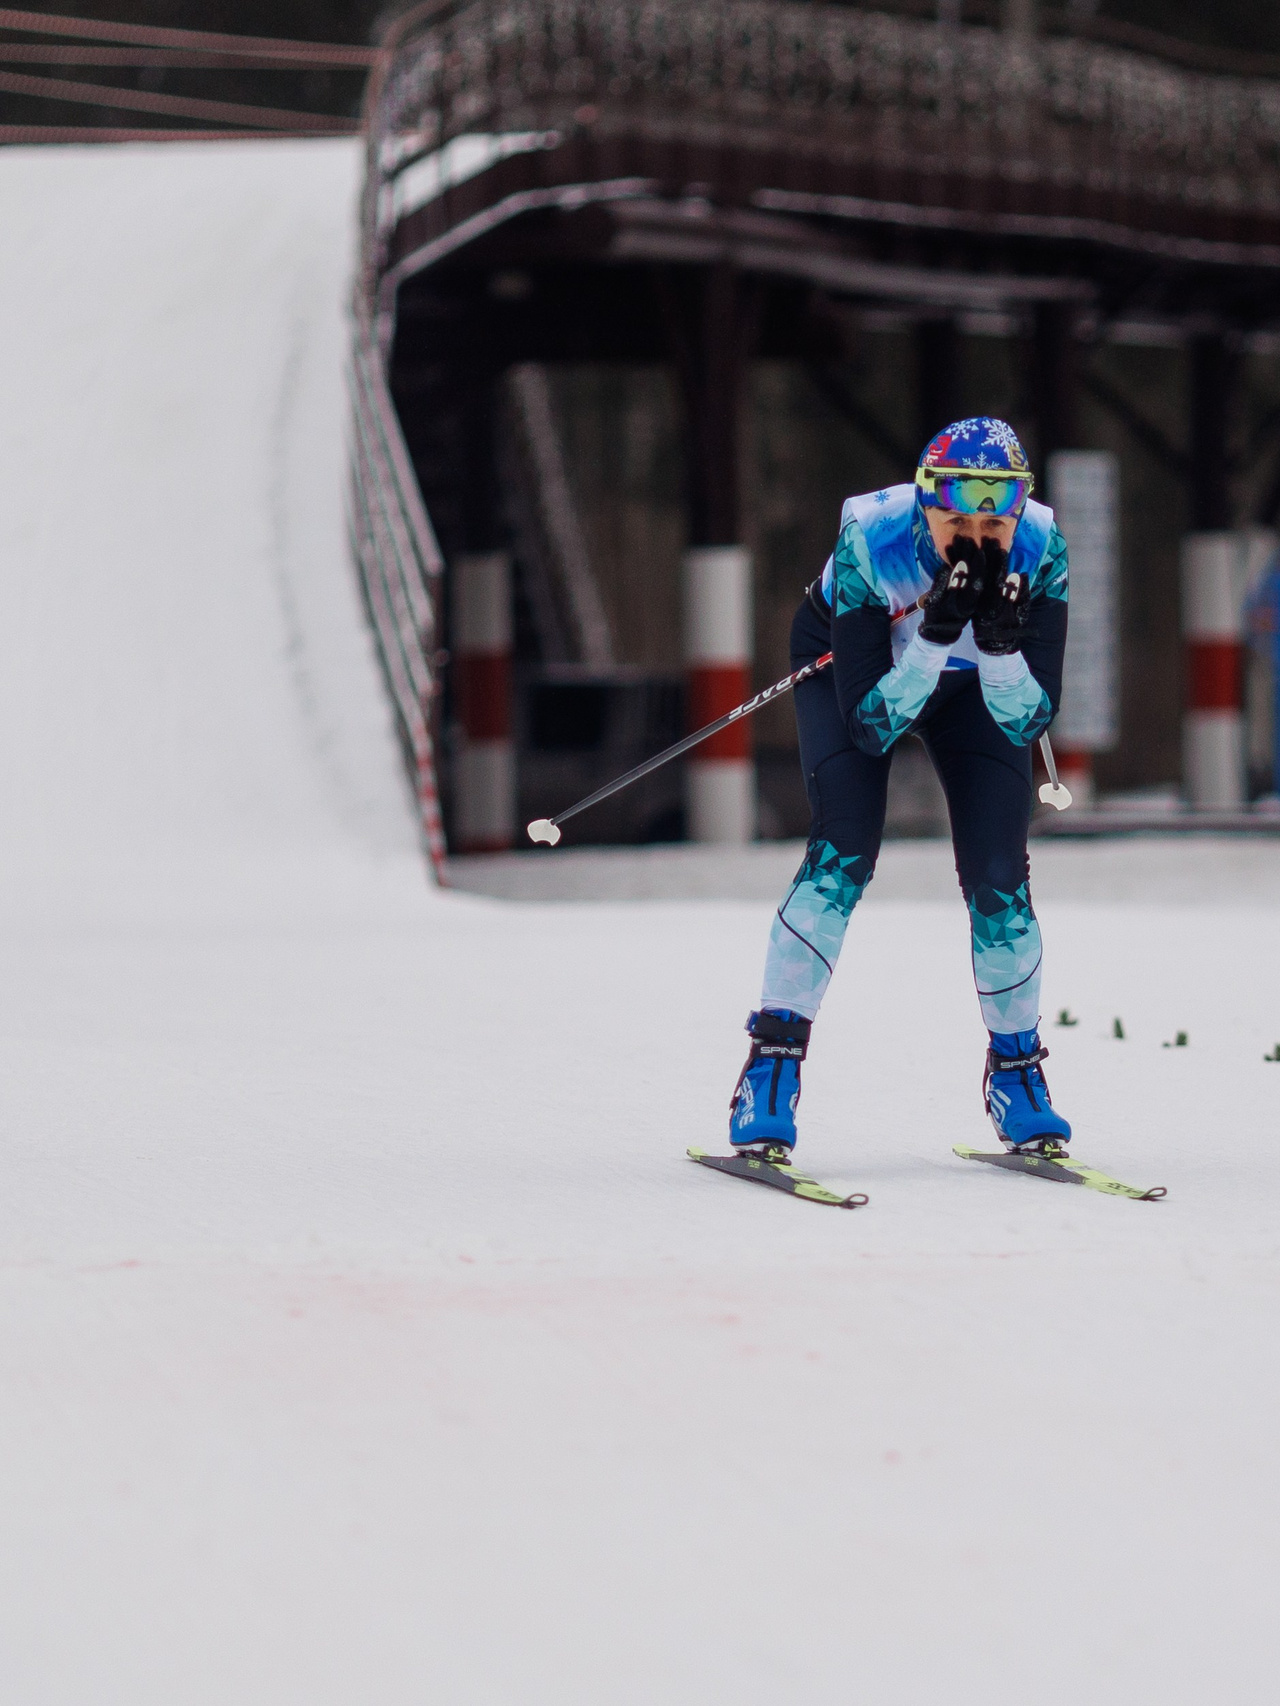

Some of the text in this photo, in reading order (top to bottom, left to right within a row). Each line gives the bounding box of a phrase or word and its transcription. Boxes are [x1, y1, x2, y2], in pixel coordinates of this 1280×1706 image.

[760, 1046, 803, 1056] SPINE
[1000, 1053, 1041, 1069] SPINE
[738, 1076, 755, 1130] SPINE
